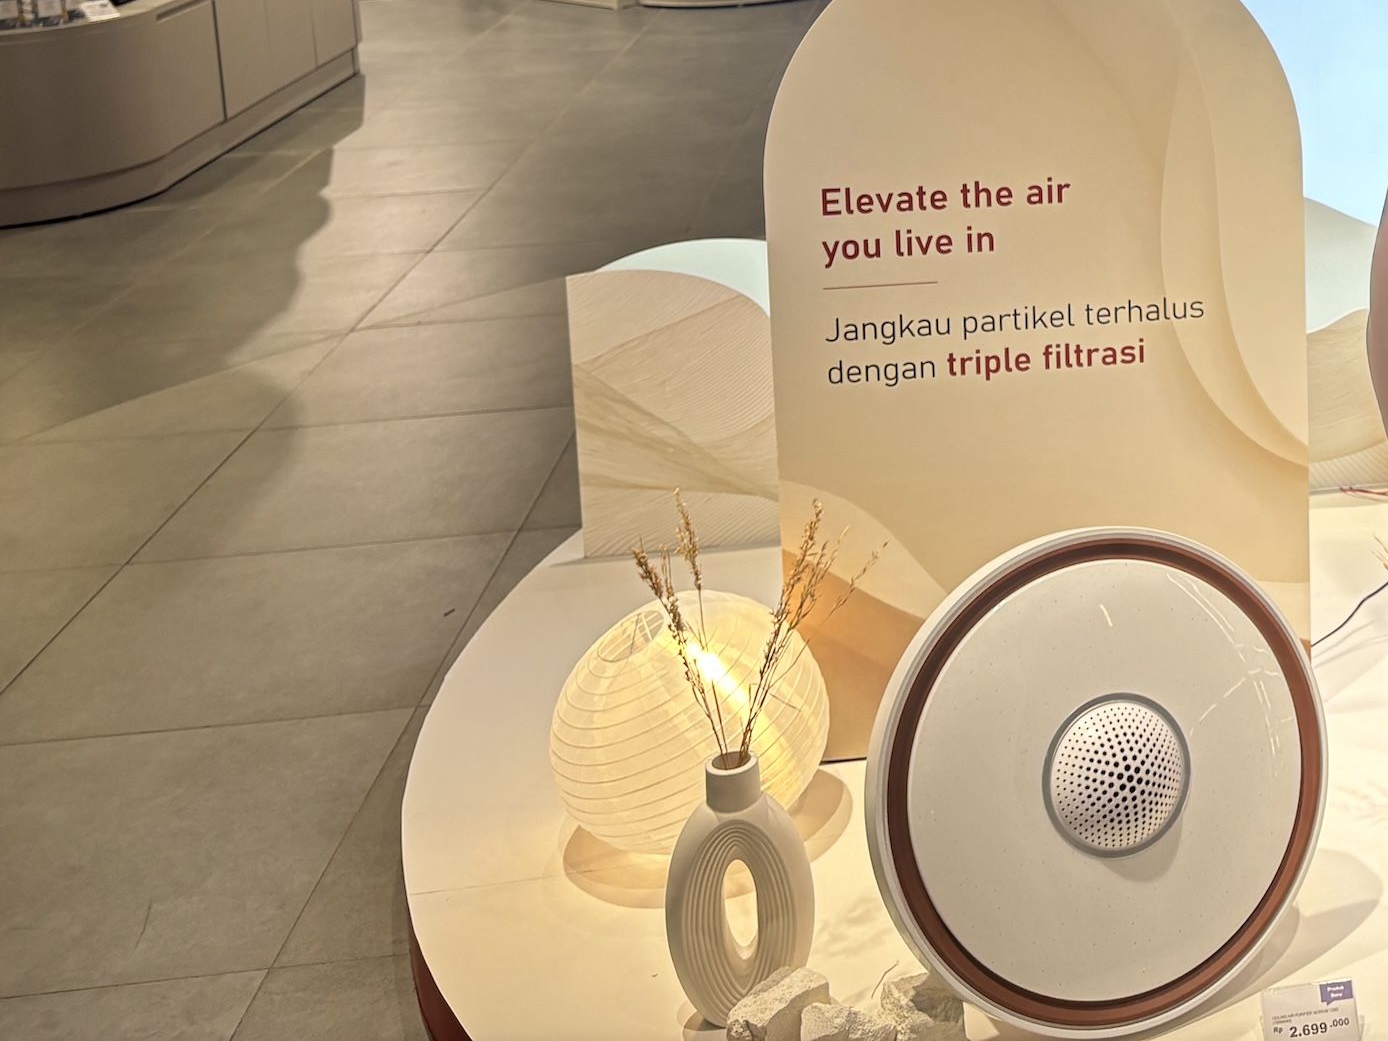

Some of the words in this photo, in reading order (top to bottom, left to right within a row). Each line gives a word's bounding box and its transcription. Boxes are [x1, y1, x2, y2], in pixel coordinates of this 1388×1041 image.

[820, 184, 948, 216] Elevate
[960, 181, 1013, 209] the
[1026, 177, 1071, 206] air
[822, 236, 881, 269] you
[894, 229, 953, 257] live
[966, 226, 995, 253] in
[825, 314, 951, 345] Jangkau
[962, 304, 1075, 340] partikel
[1085, 297, 1205, 327] terhalus
[828, 359, 936, 387] dengan
[947, 348, 1031, 381] triple
[1042, 338, 1146, 370] filtrasi
